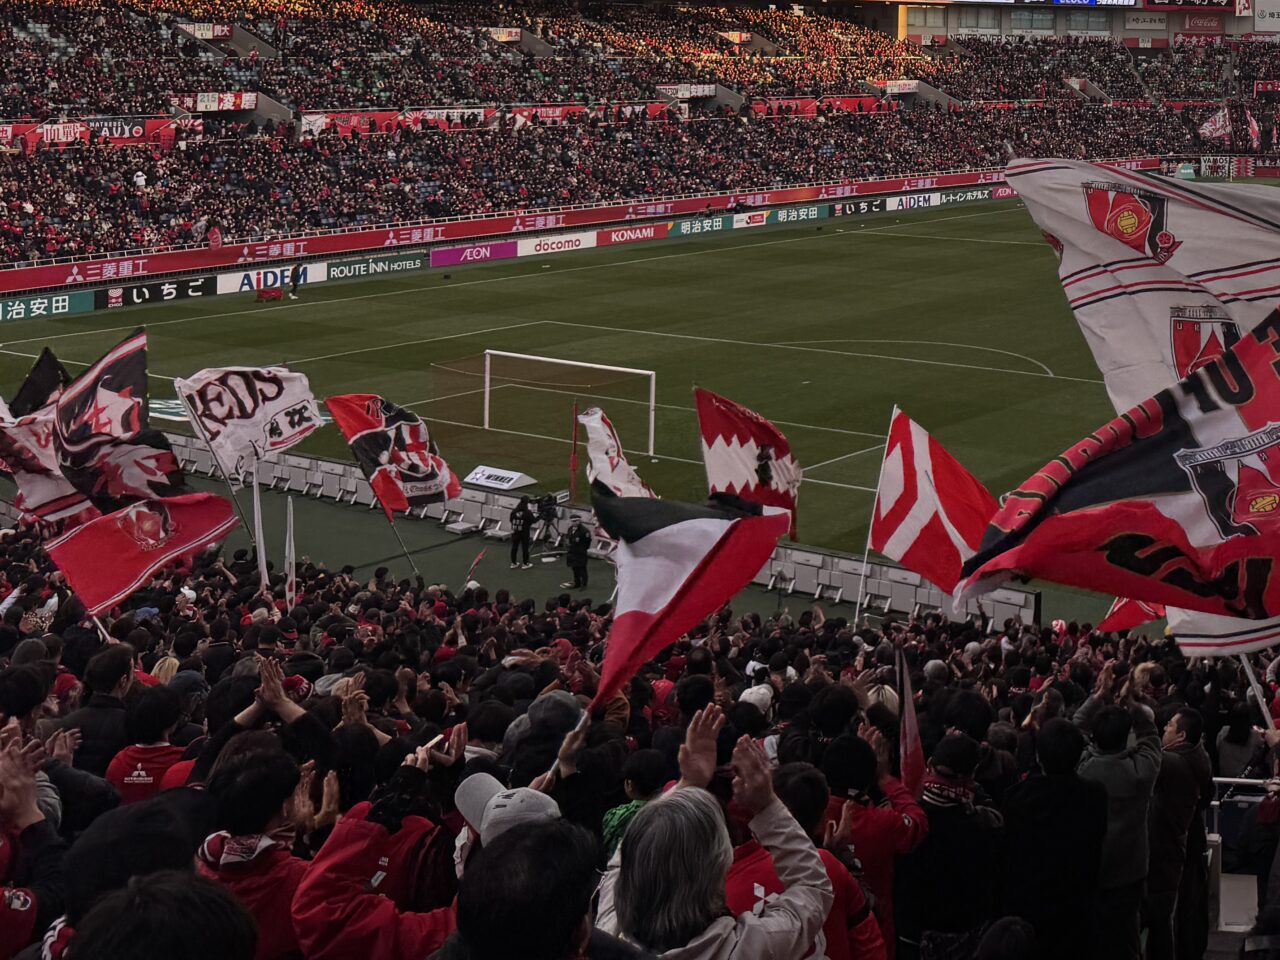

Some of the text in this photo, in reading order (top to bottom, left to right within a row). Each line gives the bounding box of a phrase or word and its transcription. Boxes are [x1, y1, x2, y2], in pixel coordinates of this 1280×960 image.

[200, 93, 217, 103] 215
[777, 206, 818, 223] 明治安田
[846, 199, 881, 215] いちご
[399, 226, 447, 244] 三菱重工
[611, 227, 655, 243] KONAMI
[681, 217, 723, 235] 明治安田
[255, 241, 309, 261] 三菱重工
[534, 238, 581, 253] docomo
[86, 259, 149, 281] 三菱重工
[330, 264, 368, 279] ROUTE
[390, 258, 421, 271] HOTELS
[132, 278, 206, 304] いちご
[0, 295, 70, 321] 治安田
